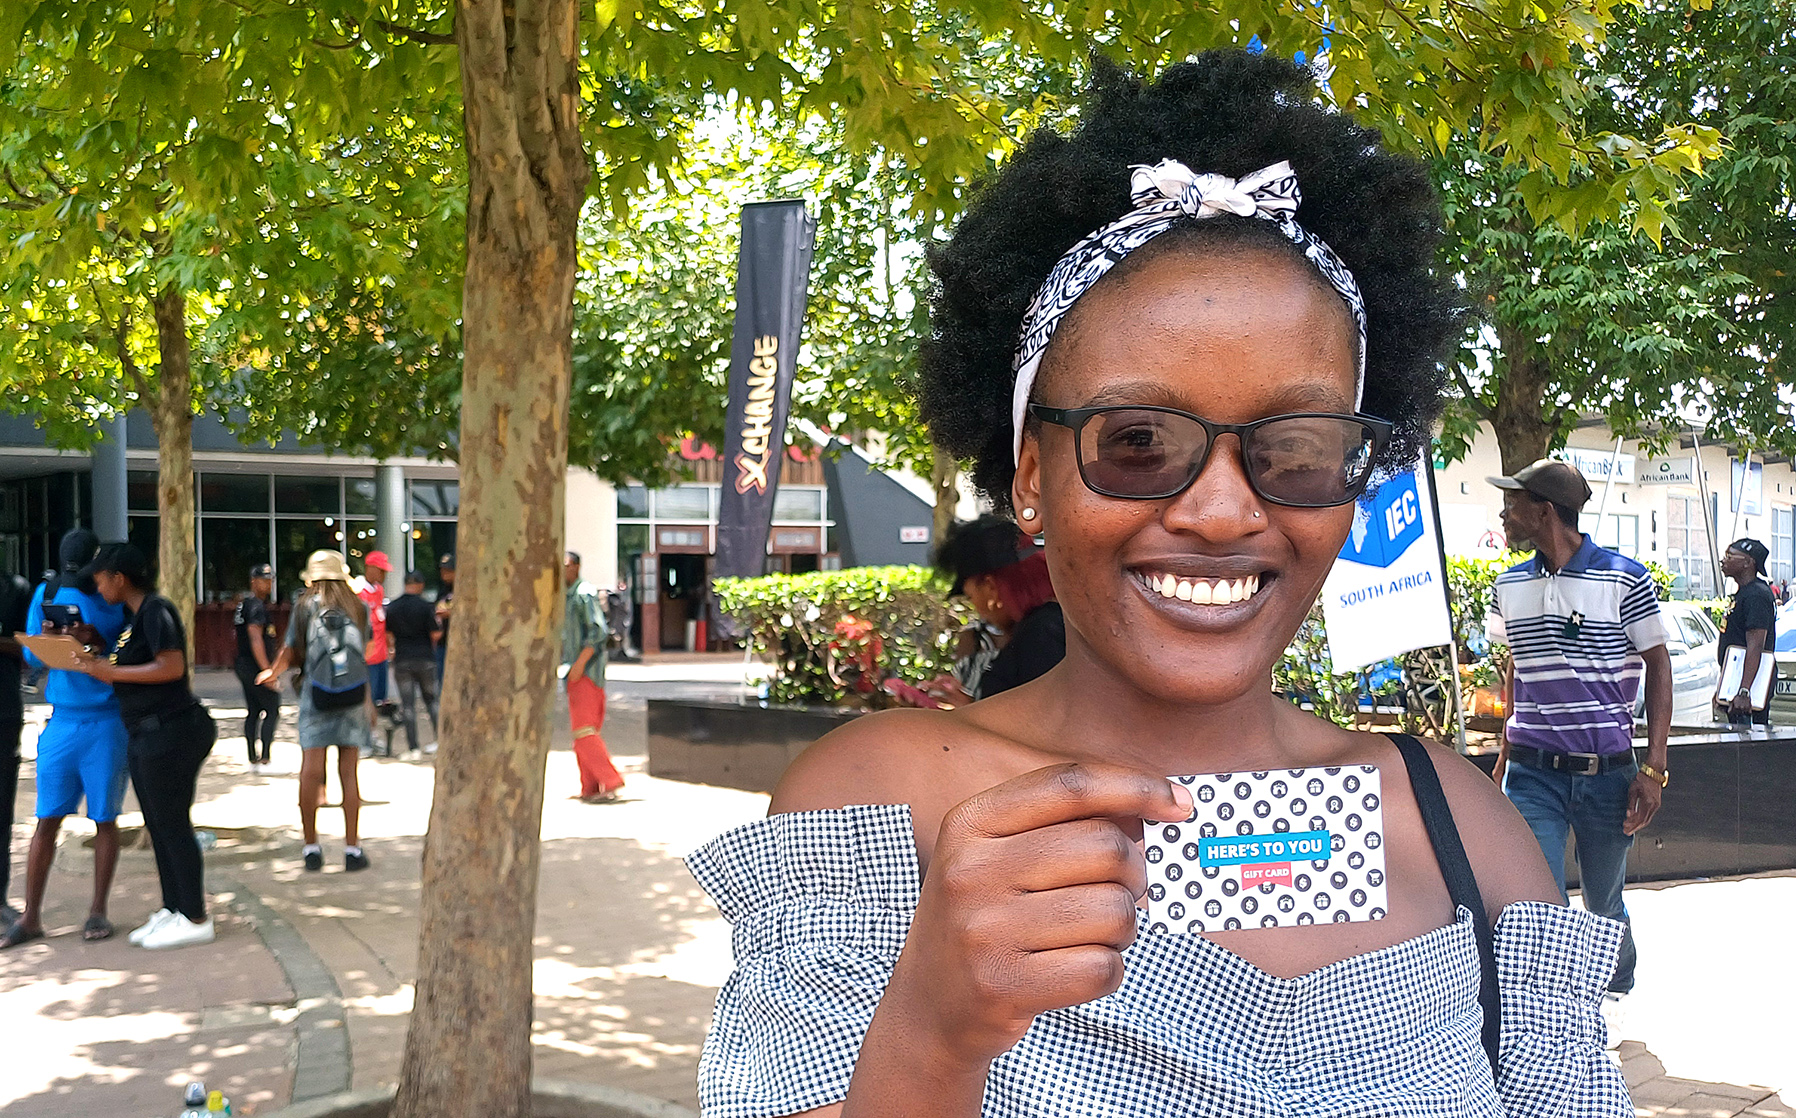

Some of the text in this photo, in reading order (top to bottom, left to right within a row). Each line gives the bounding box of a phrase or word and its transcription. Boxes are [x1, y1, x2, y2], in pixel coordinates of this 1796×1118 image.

[736, 334, 779, 494] XCHANGE
[1384, 489, 1417, 542] IEC
[1340, 571, 1433, 609] SOUTH AFRICA
[1207, 839, 1323, 860] HERE'S TO YOU
[1243, 868, 1290, 879] GIFT CARD
